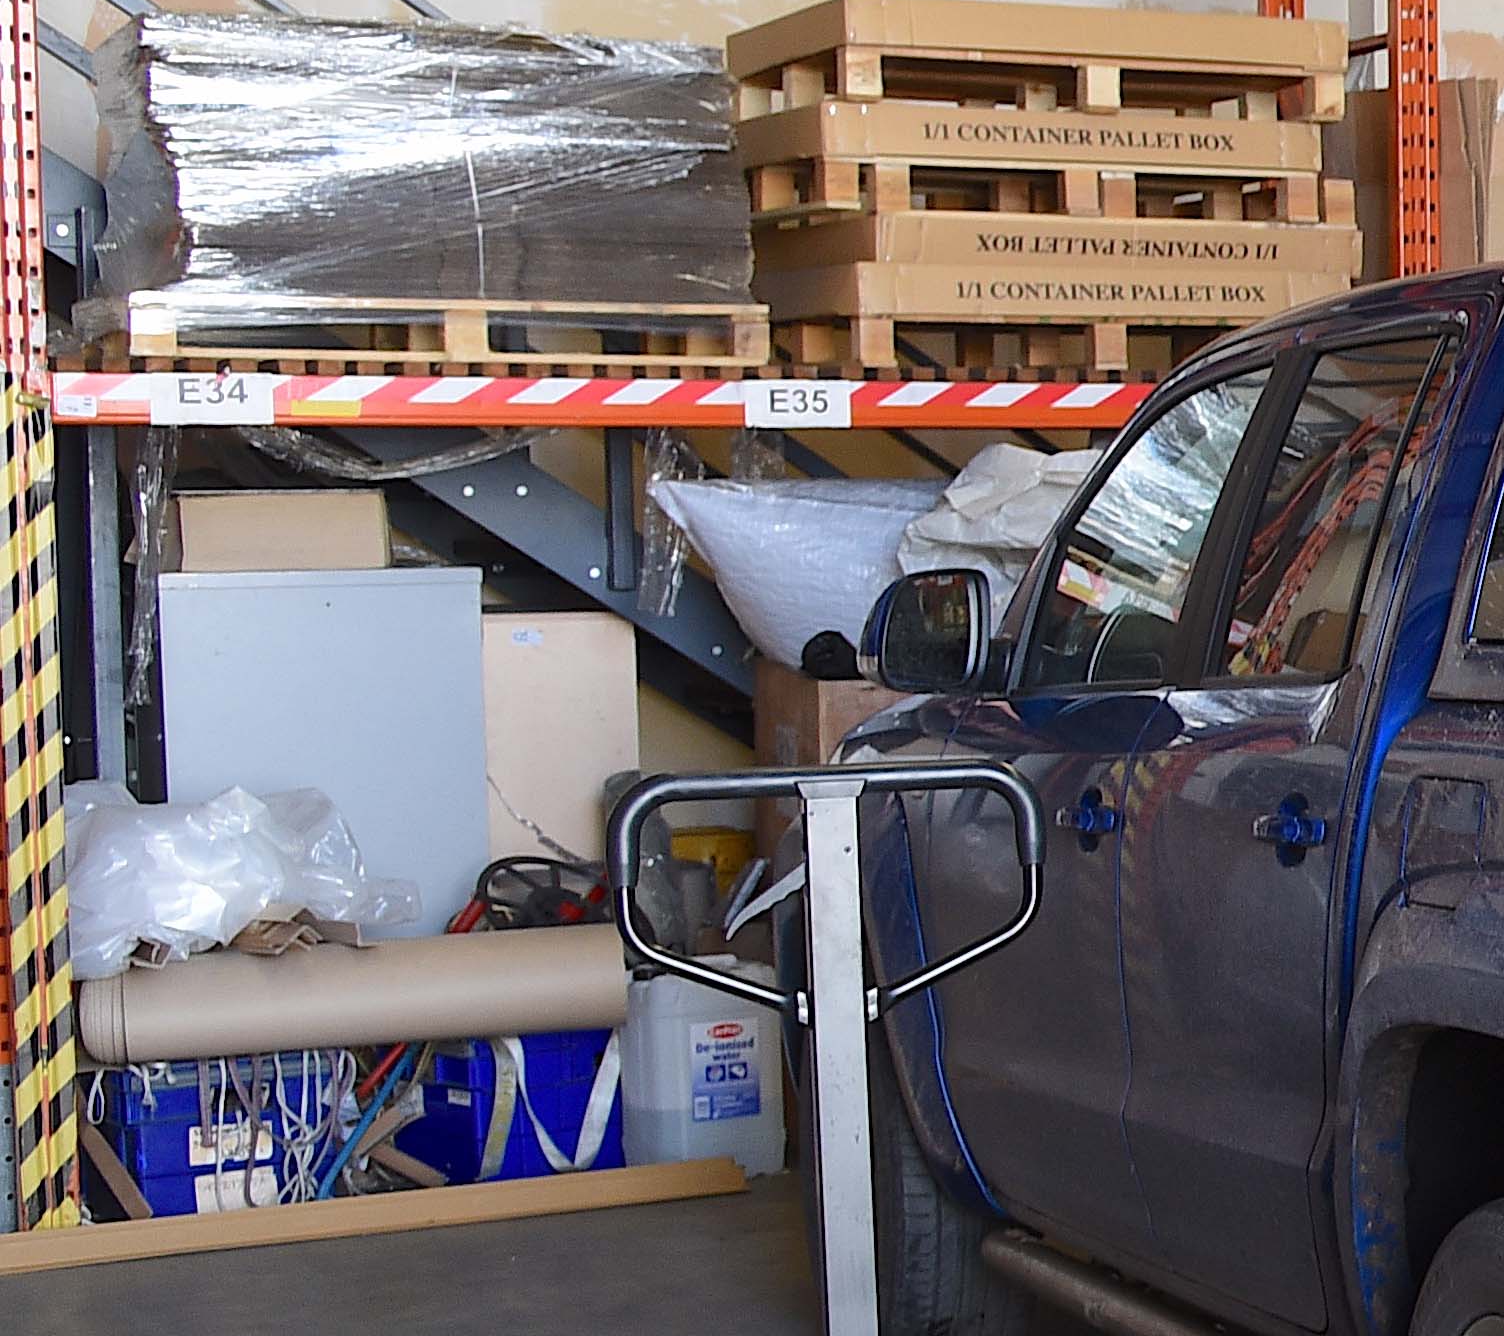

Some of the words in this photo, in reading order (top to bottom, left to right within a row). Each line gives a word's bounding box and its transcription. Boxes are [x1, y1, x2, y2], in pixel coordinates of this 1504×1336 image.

[924, 123, 949, 141] 1/1
[957, 124, 1092, 147] CONTAINER
[1100, 132, 1184, 150] PALLET
[1190, 134, 1235, 151] BOX
[977, 234, 1023, 253] BOX
[1030, 235, 1115, 256] PALLET
[1123, 239, 1248, 260] CONTAINER
[1256, 244, 1278, 261] 1/1
[957, 282, 982, 299] 1/1
[990, 282, 1124, 301] CONTAINER
[1132, 285, 1216, 301] PALLET
[1221, 285, 1266, 302] BOX
[177, 376, 249, 406] E34
[768, 388, 830, 414] E35
